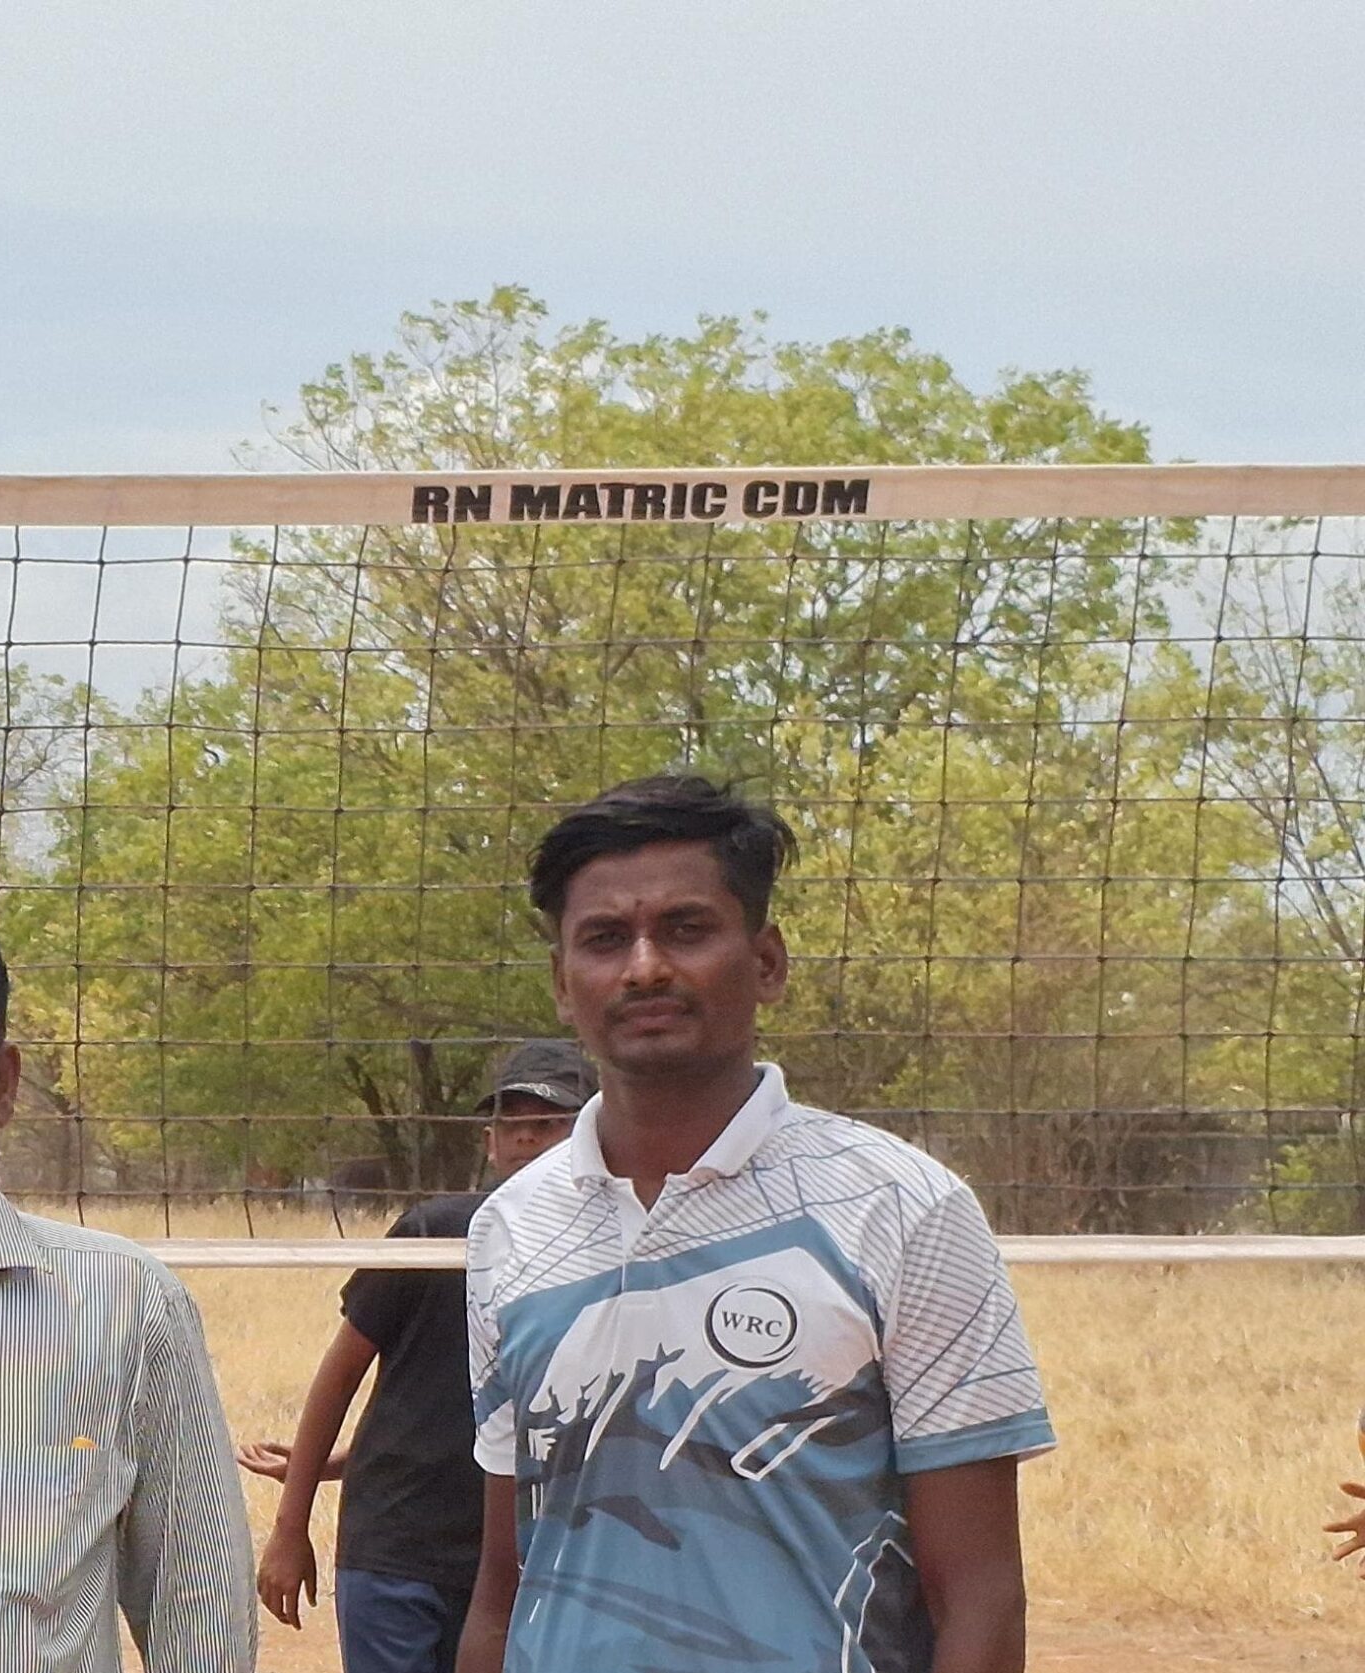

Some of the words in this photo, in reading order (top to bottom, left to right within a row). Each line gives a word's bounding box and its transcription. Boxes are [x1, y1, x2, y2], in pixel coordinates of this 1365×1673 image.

[412, 485, 492, 523] RN
[509, 481, 728, 521] MATRIC
[742, 478, 870, 518] CDM
[721, 1310, 783, 1338] WRC
